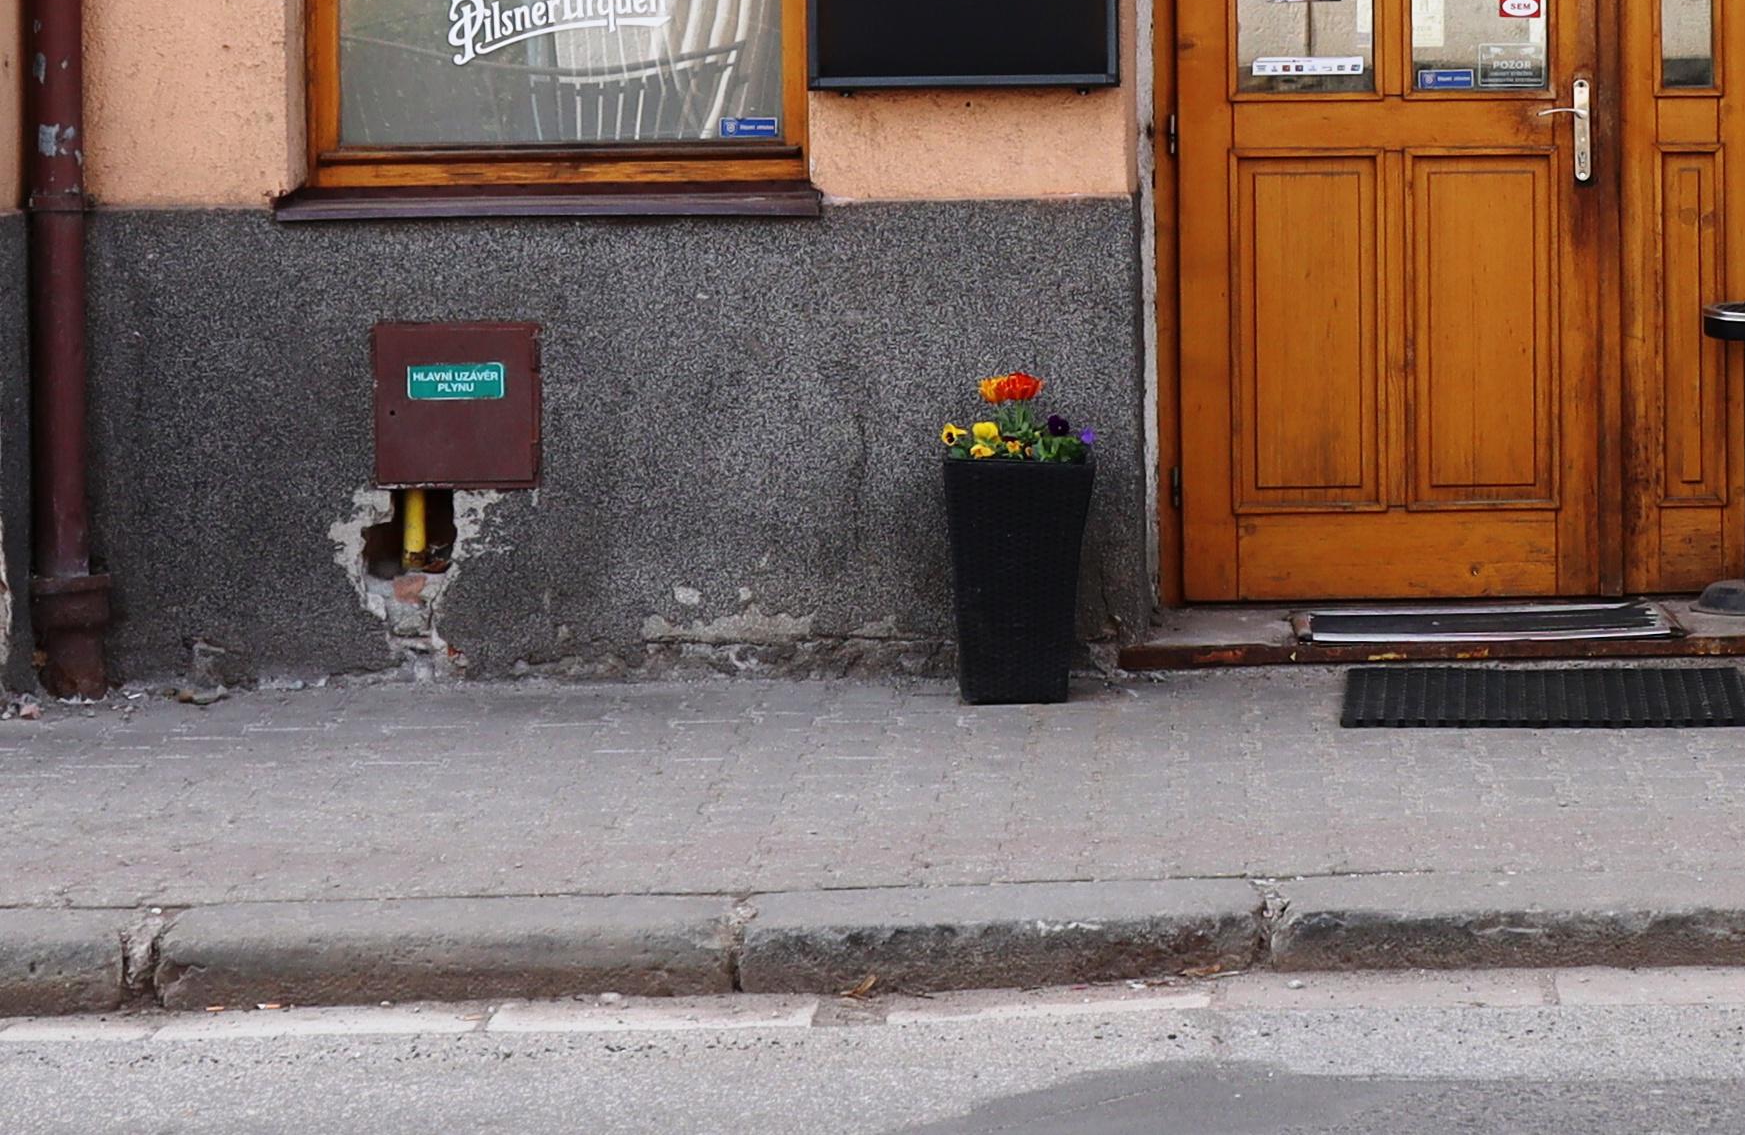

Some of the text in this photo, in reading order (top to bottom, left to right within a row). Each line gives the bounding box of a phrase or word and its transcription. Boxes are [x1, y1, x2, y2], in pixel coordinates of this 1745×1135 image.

[1492, 60, 1532, 70] POZOR
[413, 369, 499, 382] HLAVNÍ UZÁVĚR
[437, 382, 475, 393] PLYNU
